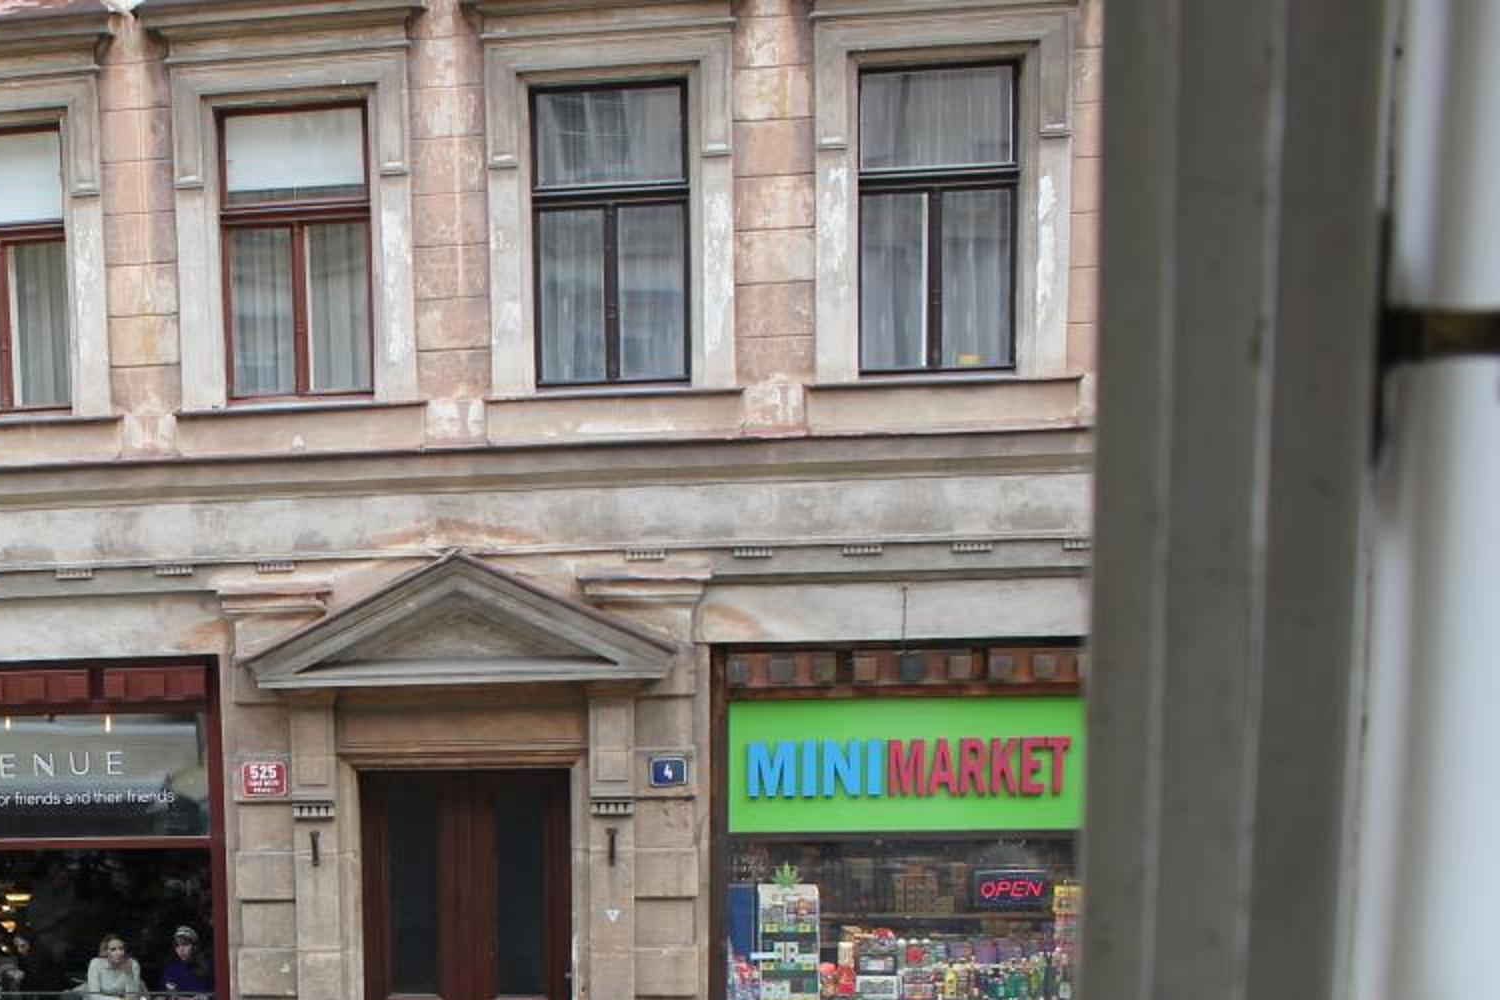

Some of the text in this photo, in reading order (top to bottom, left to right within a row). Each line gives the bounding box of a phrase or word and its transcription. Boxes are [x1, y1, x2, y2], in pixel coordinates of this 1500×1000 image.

[250, 765, 277, 779] 525
[664, 763, 673, 779] 4
[15, 790, 60, 805] friends
[65, 790, 91, 805] and
[94, 789, 123, 804] their
[981, 880, 1044, 898] OPEN
